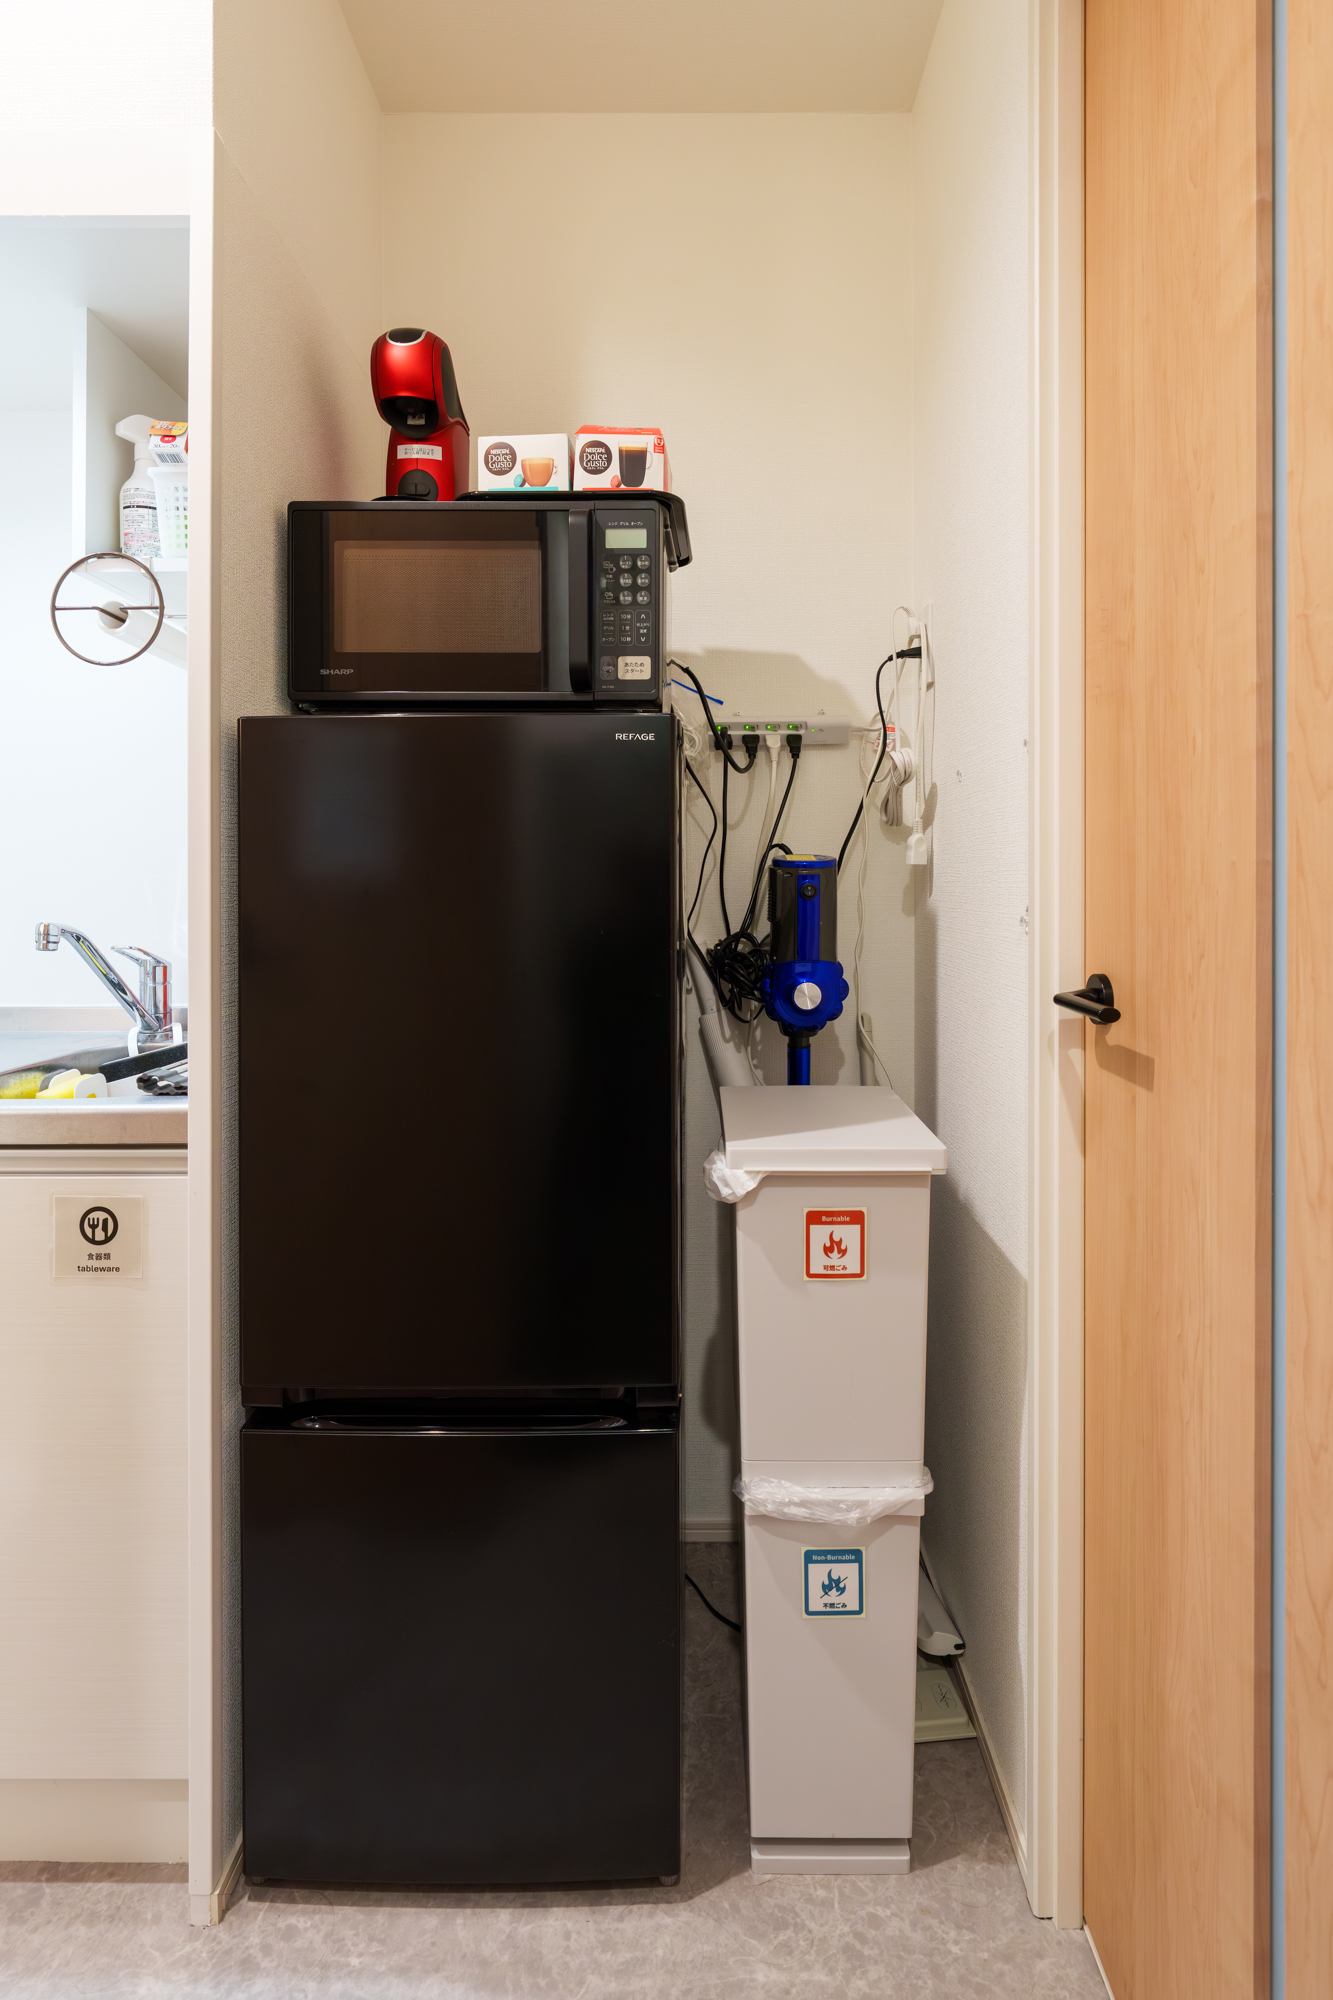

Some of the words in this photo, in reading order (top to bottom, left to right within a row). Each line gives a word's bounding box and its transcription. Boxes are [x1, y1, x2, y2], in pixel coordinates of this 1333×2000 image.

[490, 447, 511, 455] NESCAFÉ
[585, 446, 606, 454] NESCAFÉ
[488, 453, 512, 462] Dolce
[583, 452, 608, 461] Dolce
[488, 461, 513, 469] Gusto
[583, 460, 608, 468] Gusto
[615, 733, 656, 741] REFAGE
[87, 1252, 111, 1261] 食器類
[823, 1264, 848, 1272] 可燃ごみ
